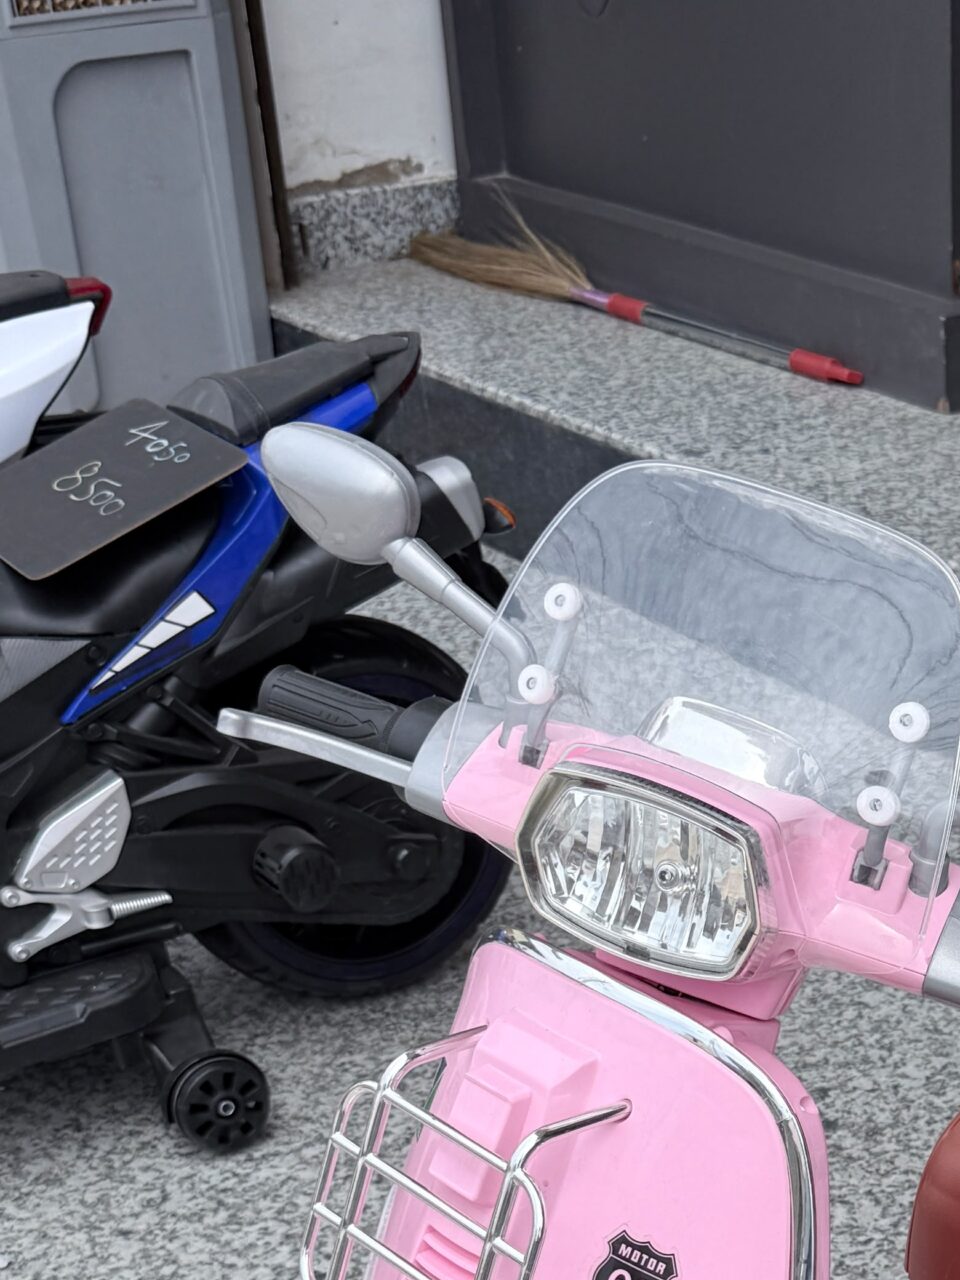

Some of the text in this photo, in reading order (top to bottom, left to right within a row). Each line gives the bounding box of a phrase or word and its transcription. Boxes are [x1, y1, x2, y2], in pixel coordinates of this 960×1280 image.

[124, 420, 191, 463] 4050
[52, 460, 126, 517] 8500
[618, 1243, 667, 1275] MOTOR
